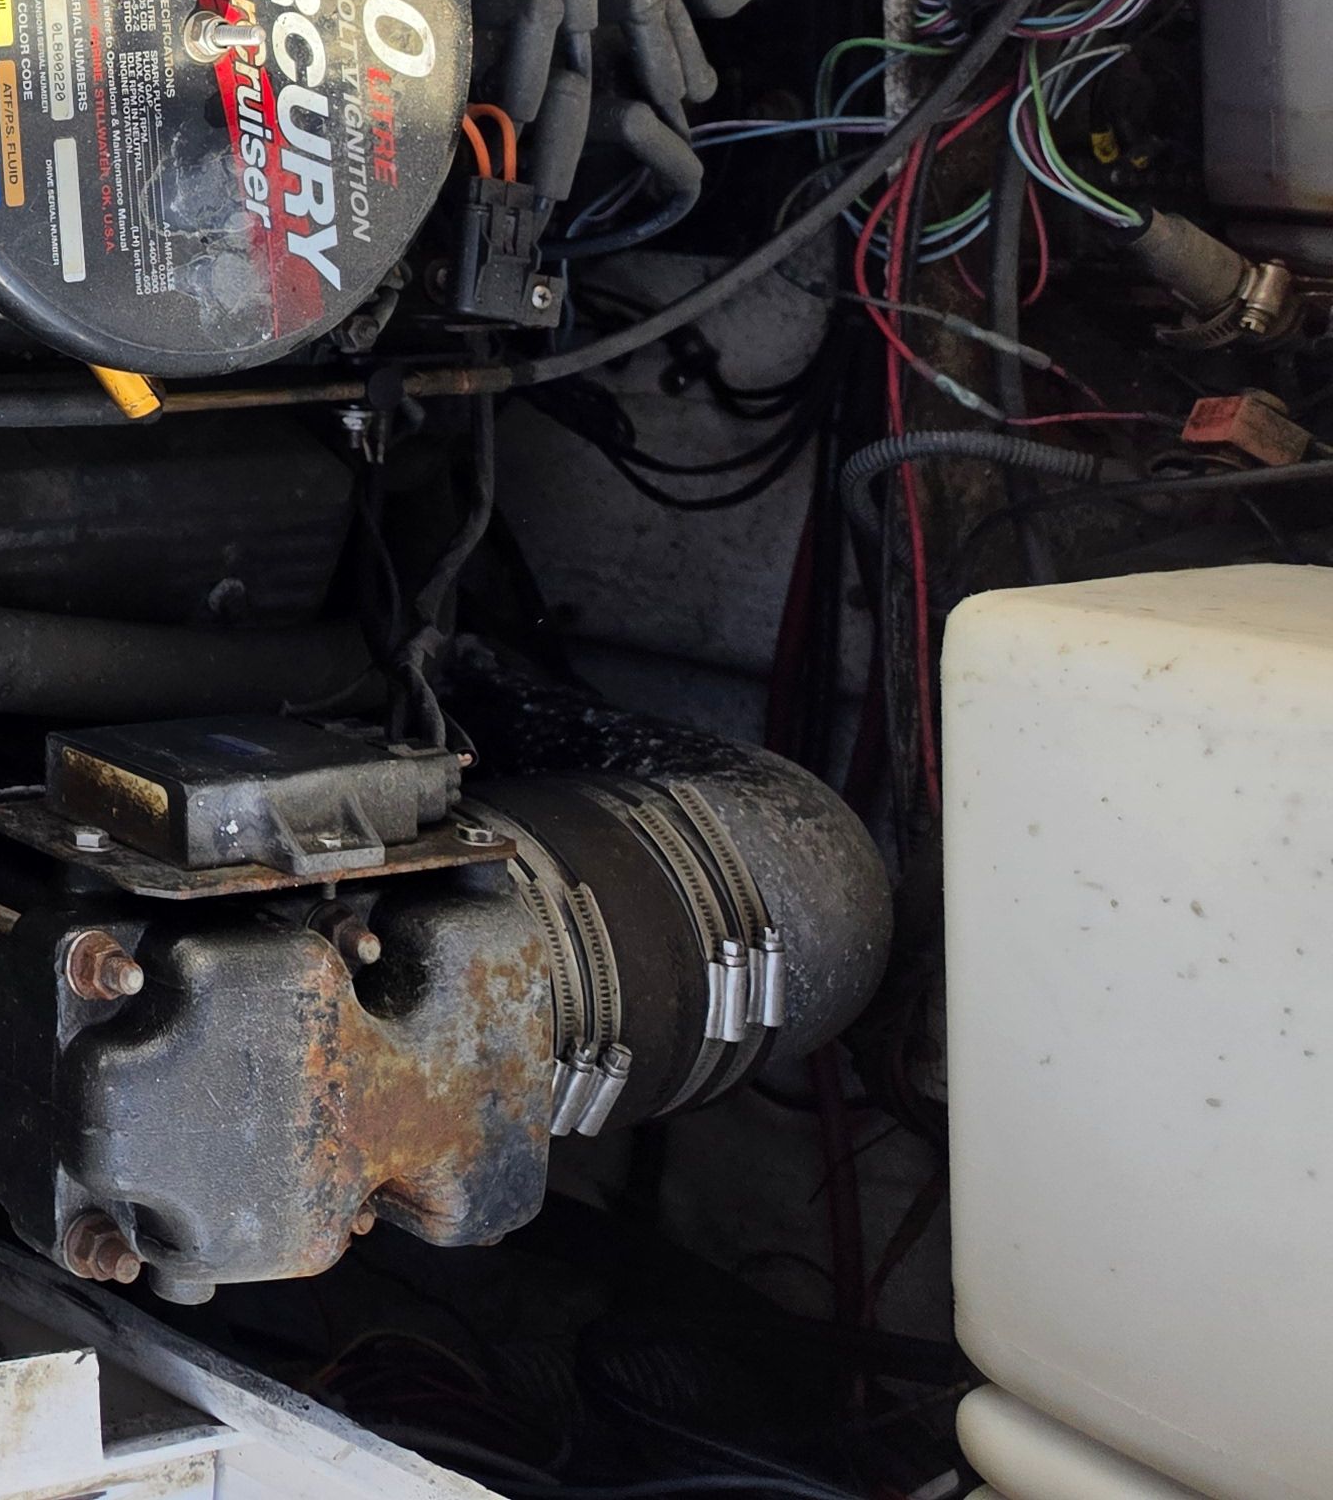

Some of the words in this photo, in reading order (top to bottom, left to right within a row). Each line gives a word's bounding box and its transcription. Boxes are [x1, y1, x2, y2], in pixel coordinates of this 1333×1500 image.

[17, 2, 30, 56] COLOR
[102, 5, 111, 32] refer
[52, 22, 66, 102] 0L800220
[104, 36, 112, 49] to
[21, 58, 33, 101] CODE
[74, 37, 88, 112] NUMBERS
[106, 51, 118, 116] Operations
[119, 52, 129, 95] ENGINE
[127, 52, 135, 77] IDLE
[142, 50, 151, 81] PLUG
[150, 50, 160, 88] SPARK
[342, 63, 360, 93] V
[2, 82, 15, 138] ATF/P.S.
[39, 71, 49, 113] NUMBER
[128, 80, 137, 106] RPM
[131, 108, 139, 119] IN
[134, 51, 144, 80] MAX.
[139, 117, 149, 143] RPM
[145, 83, 154, 108] GAP
[153, 90, 163, 128] PLUGS
[111, 118, 119, 126] &
[122, 98, 133, 154] ROTATION
[367, 67, 399, 190] LITRE
[6, 142, 19, 186] FLUID
[112, 129, 125, 206] Maintenance
[132, 121, 142, 171] NEUTRAL
[343, 93, 372, 243] IGNITION
[46, 159, 54, 188] DRIVE
[50, 224, 59, 266] NUMBER
[118, 208, 129, 252] Manual
[133, 249, 141, 267] left
[135, 269, 144, 296] hand
